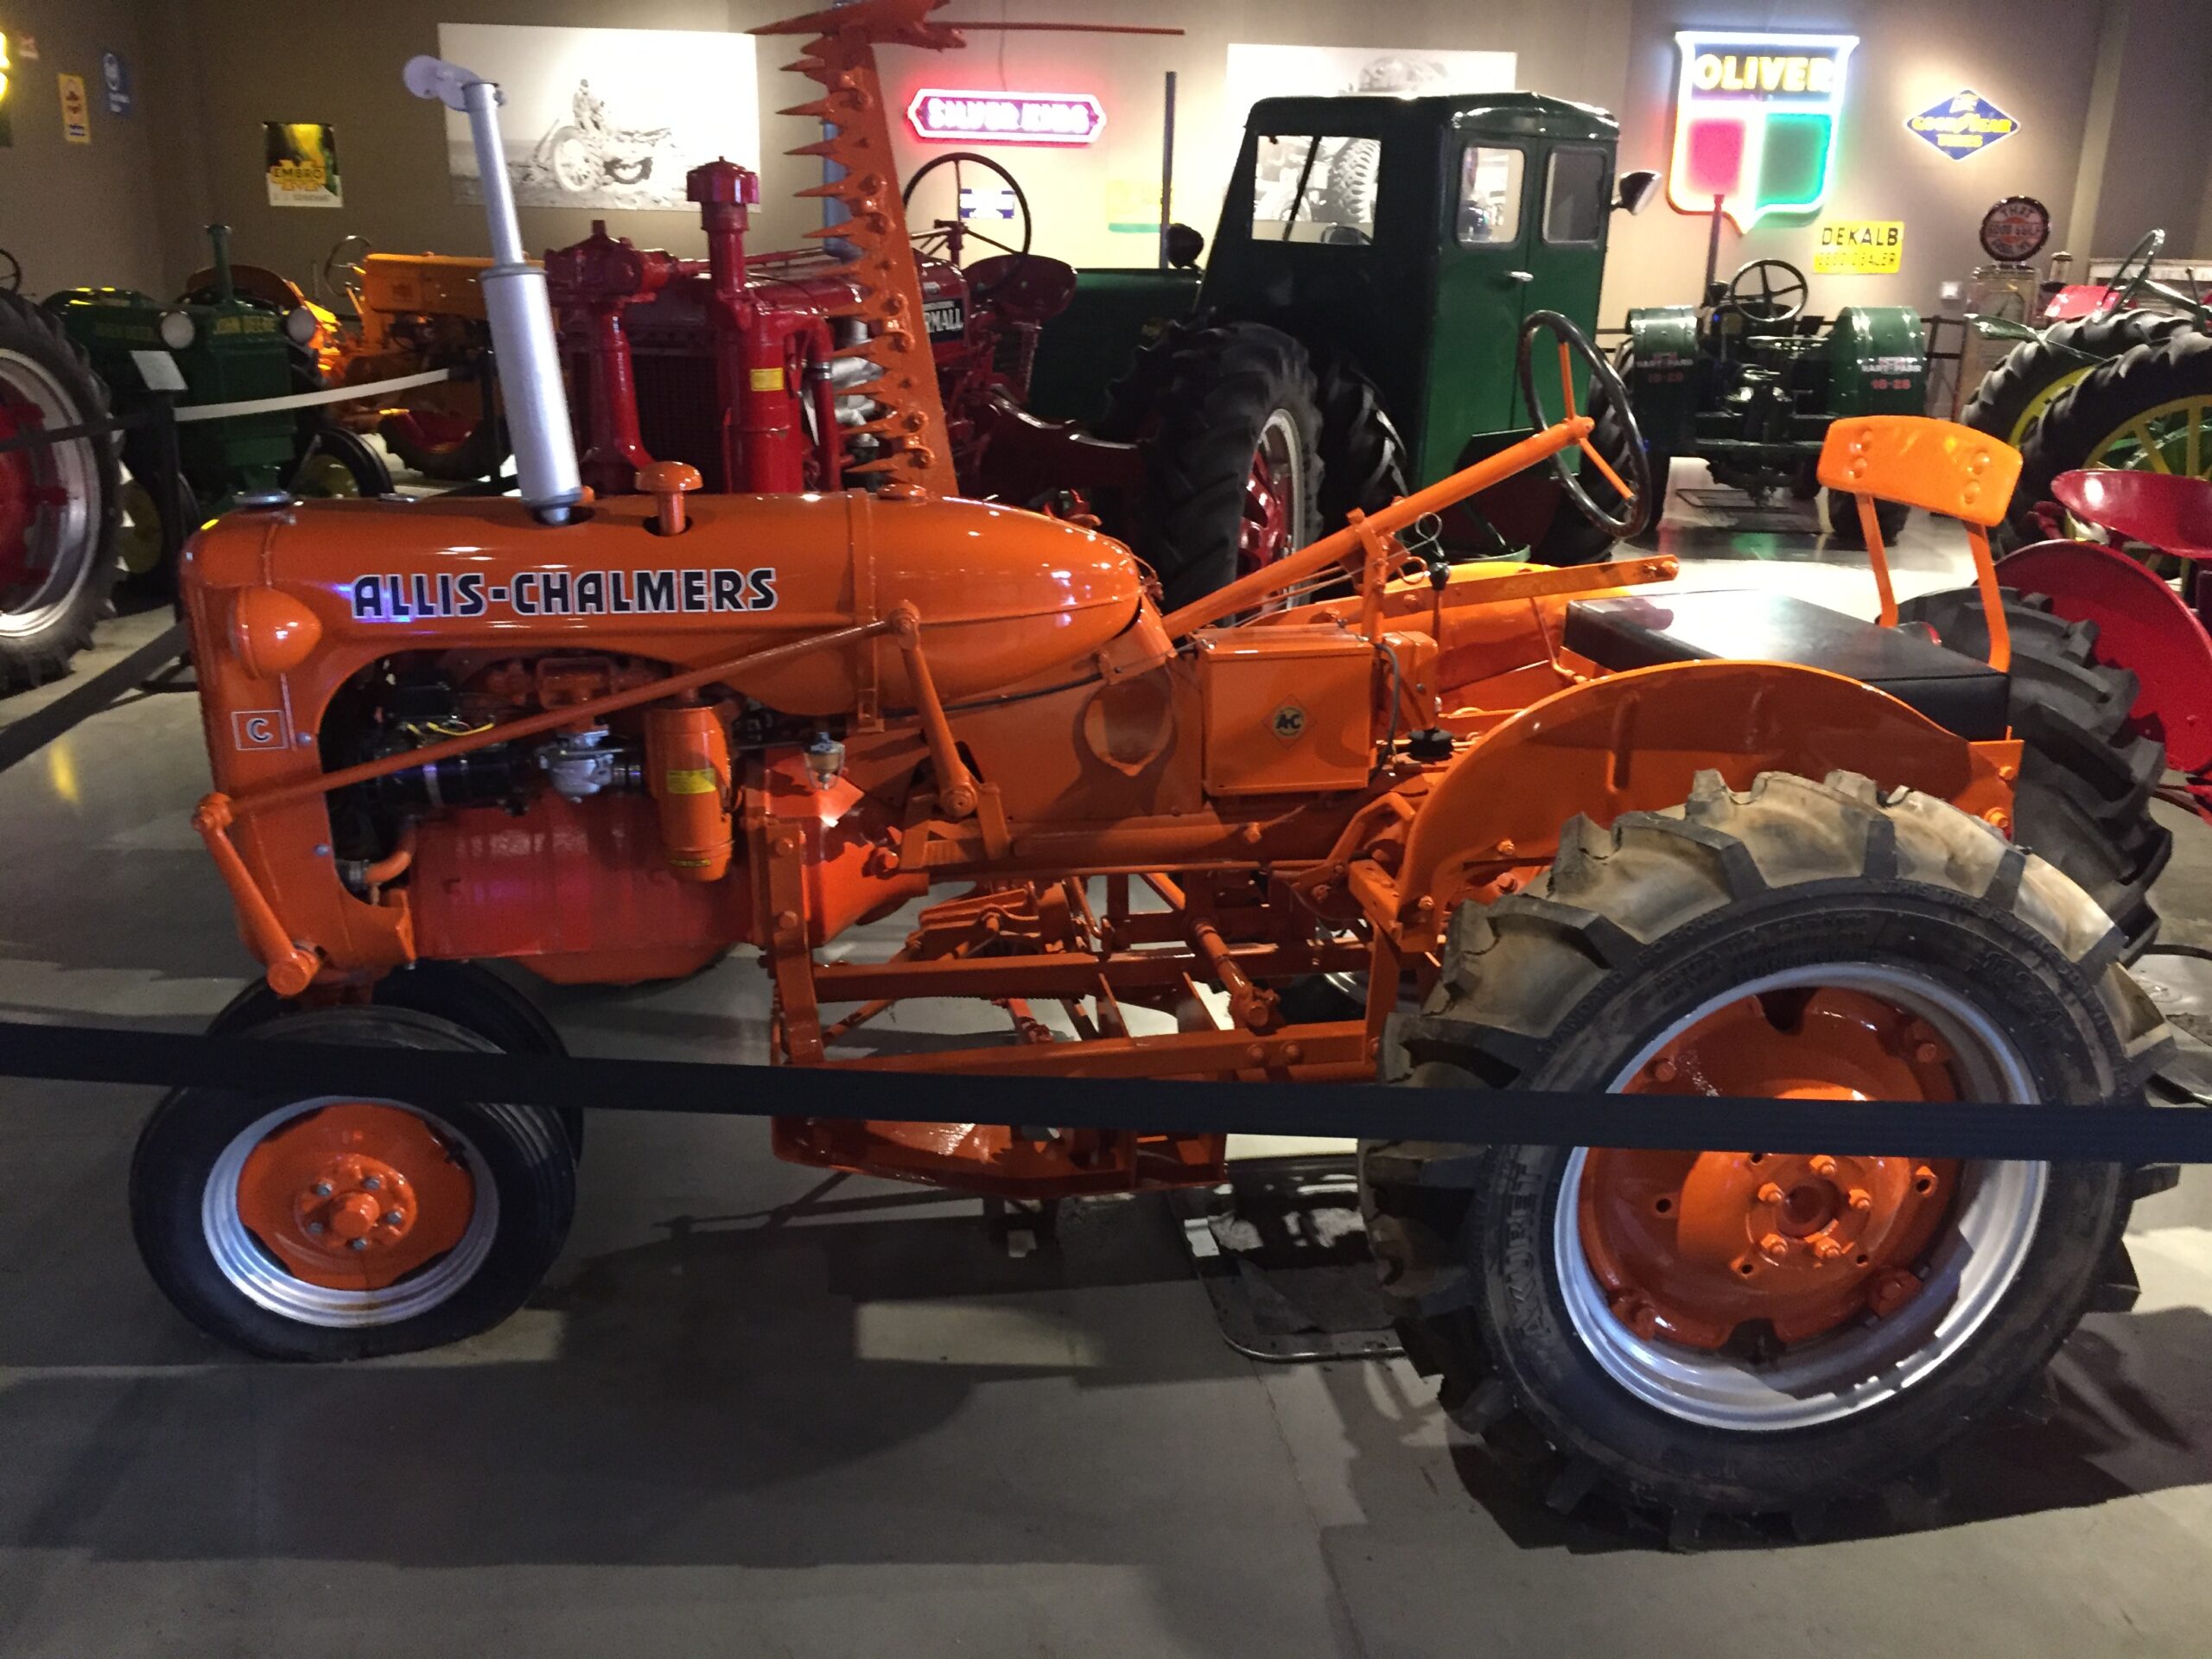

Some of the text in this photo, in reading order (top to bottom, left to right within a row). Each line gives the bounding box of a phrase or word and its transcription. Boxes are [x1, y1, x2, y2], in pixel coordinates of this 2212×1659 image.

[1693, 54, 1834, 92] OLIVER
[1821, 227, 1898, 246] DEKALB
[352, 568, 779, 619] ALLIS-CHALMERS
[246, 717, 273, 743] C
